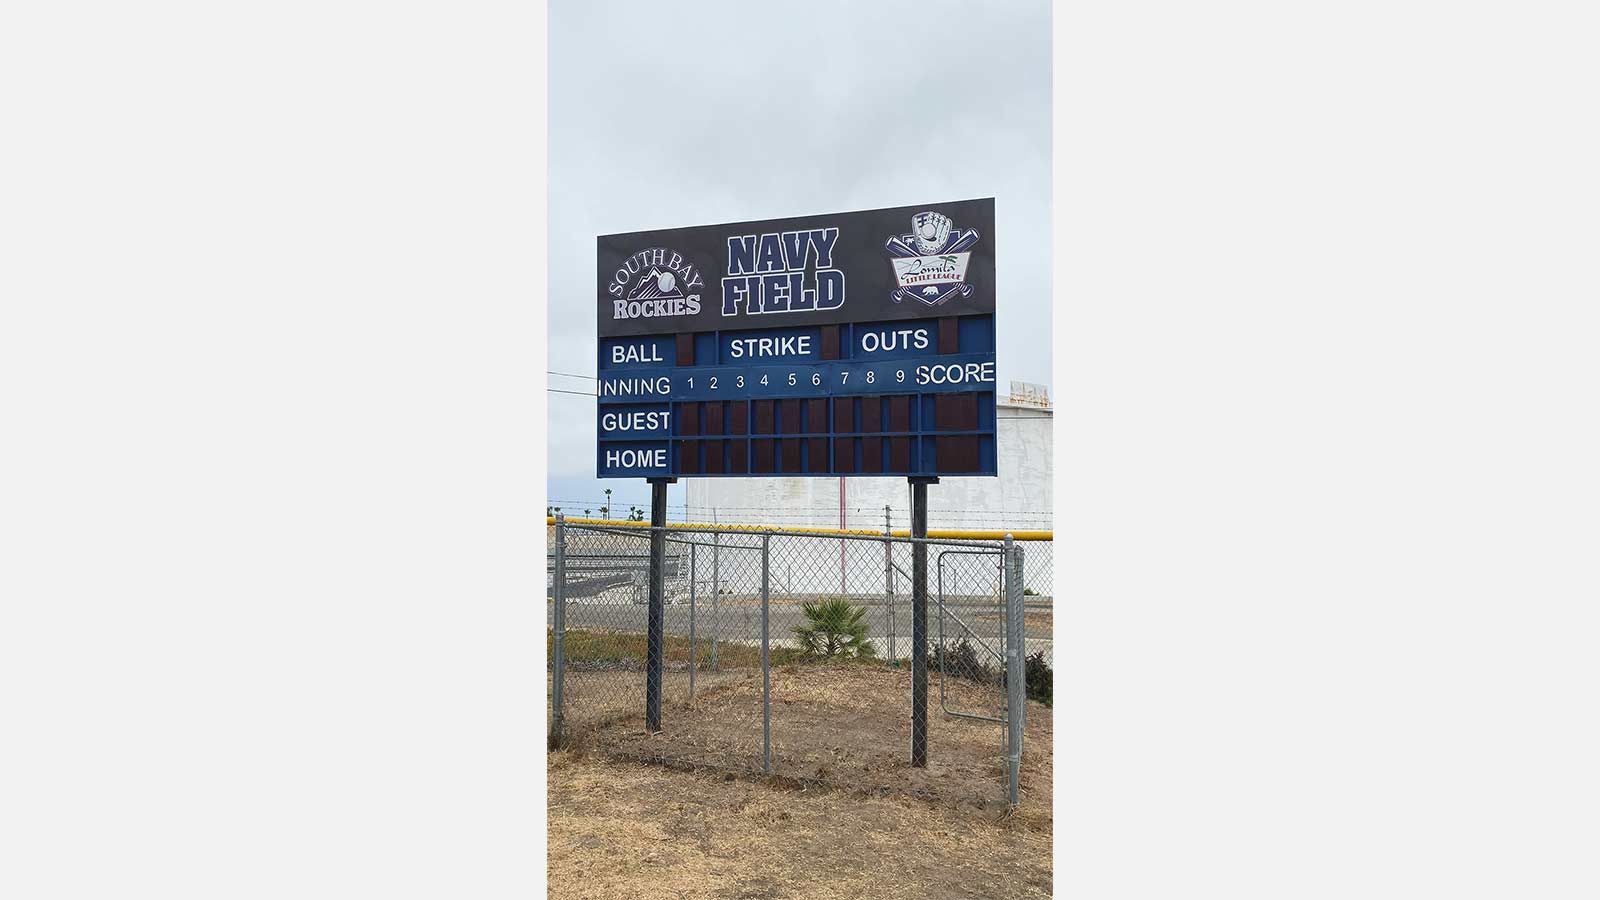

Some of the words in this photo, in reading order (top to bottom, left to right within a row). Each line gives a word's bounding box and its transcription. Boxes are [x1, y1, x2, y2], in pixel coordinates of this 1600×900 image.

[728, 227, 839, 276] NAVY
[608, 248, 664, 297] SOUTH
[668, 252, 704, 290] BAY
[613, 294, 701, 319] ROCKIES
[722, 269, 846, 317] FIELD
[613, 344, 663, 362] BALL
[731, 336, 810, 357] STRIKE
[862, 329, 928, 351] OUTS
[599, 377, 670, 396] INNING
[687, 377, 694, 389] 1
[710, 376, 718, 389] 2
[736, 375, 745, 388] 3
[760, 374, 769, 386] 4
[788, 373, 797, 386] 5
[812, 373, 821, 386] 6
[840, 371, 849, 385] 7
[866, 370, 875, 384] 8
[896, 369, 905, 383] 9
[916, 362, 994, 384] SCORE
[603, 412, 669, 430] GUEST
[607, 450, 666, 467] HOME
